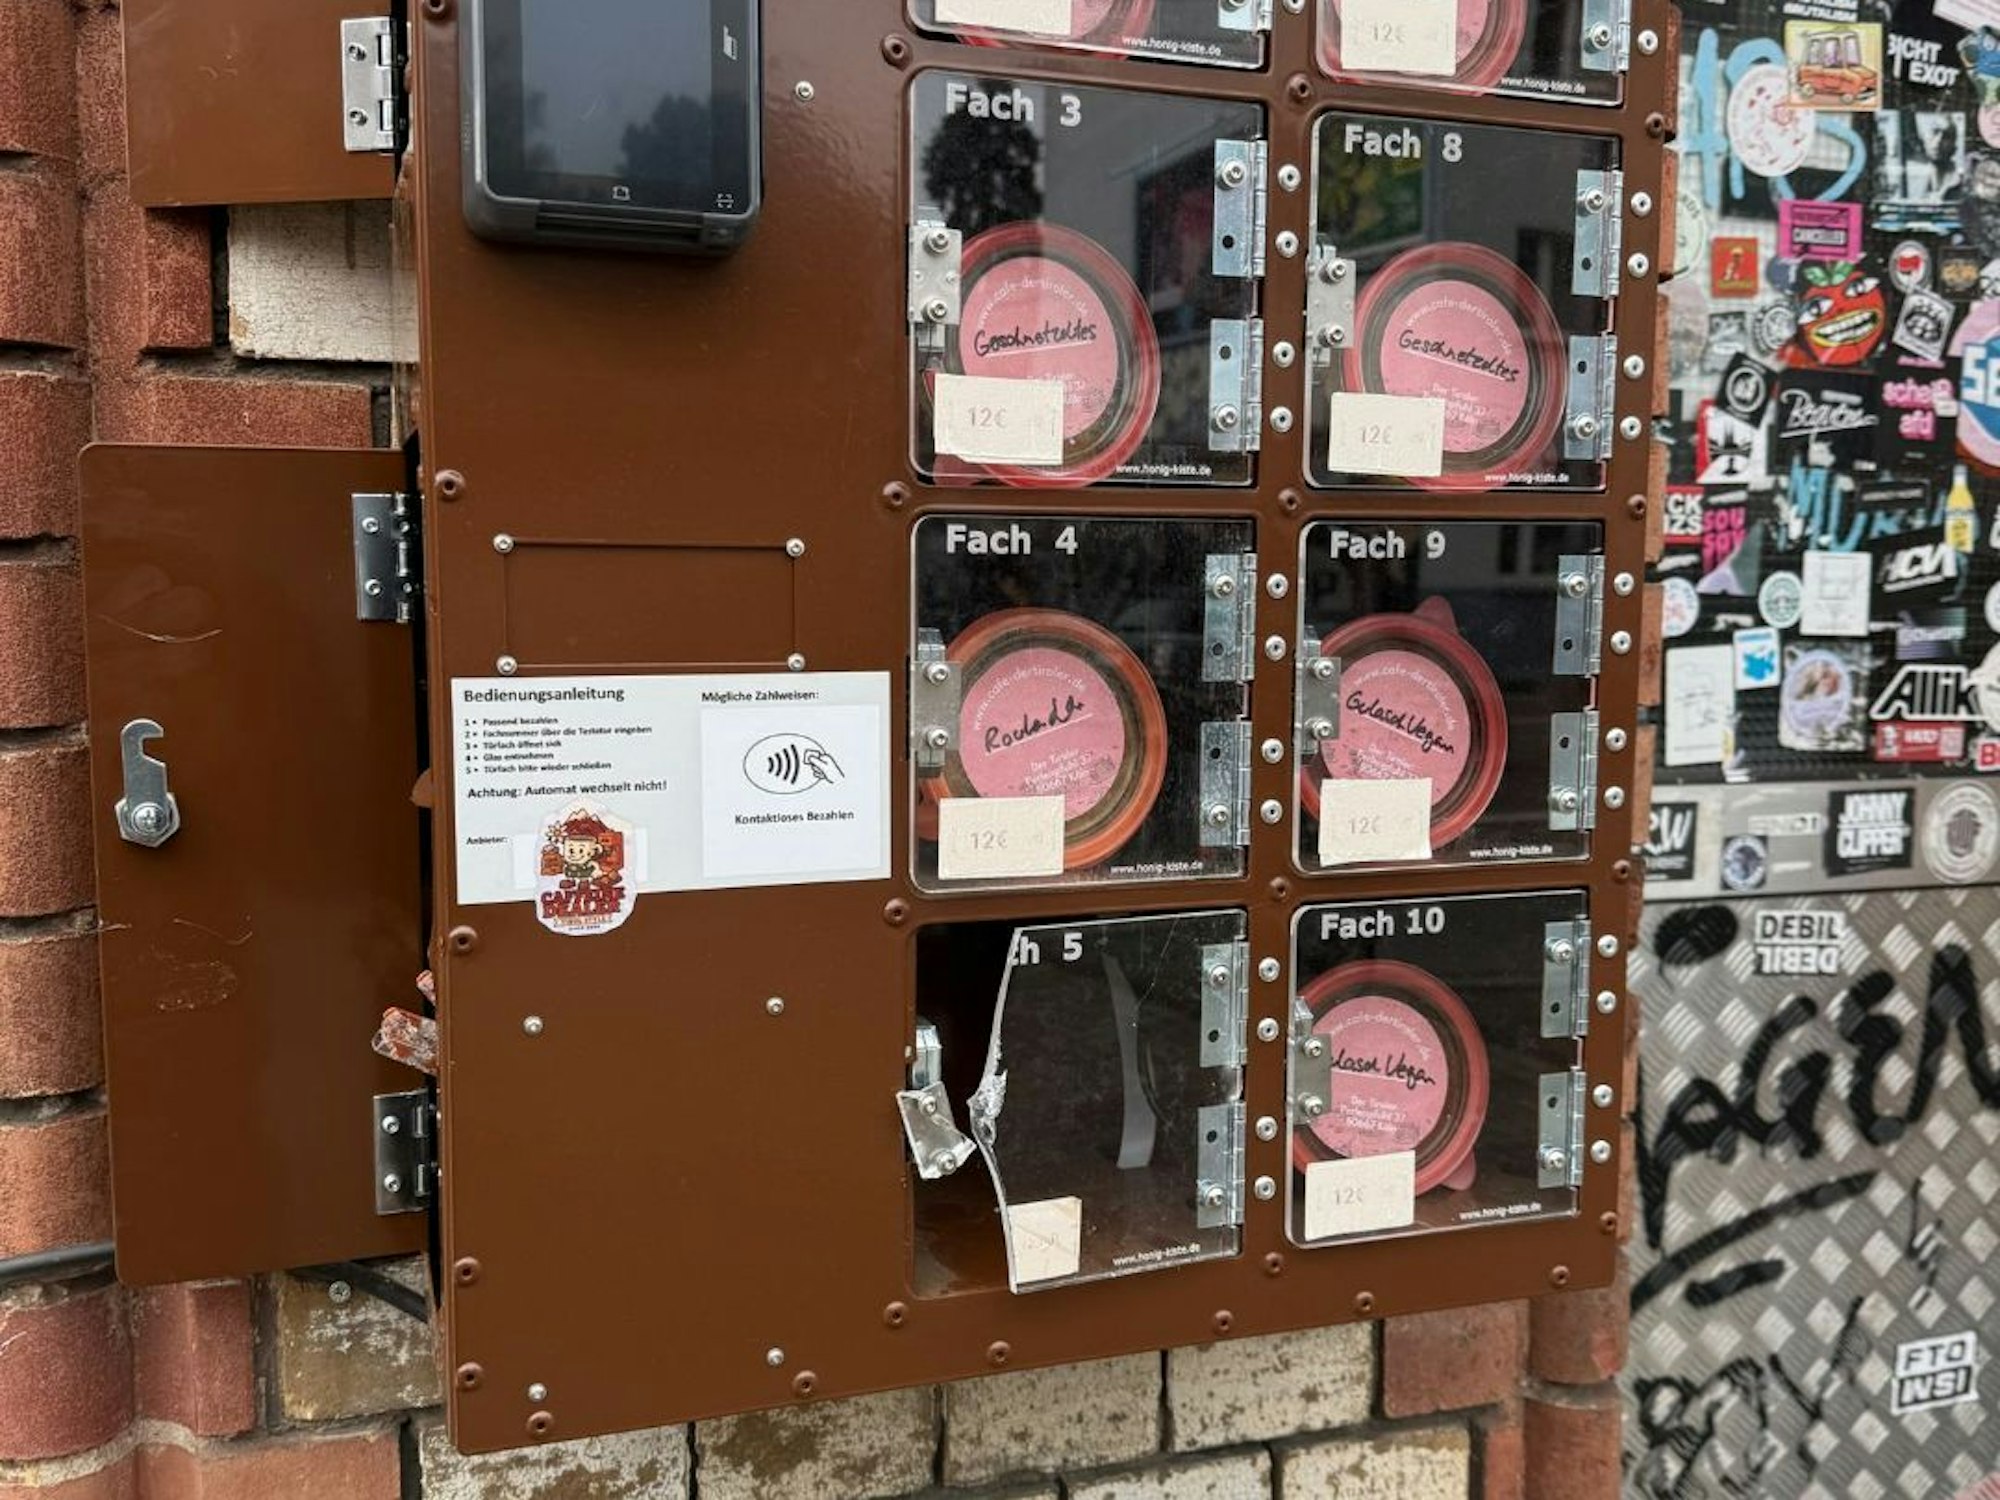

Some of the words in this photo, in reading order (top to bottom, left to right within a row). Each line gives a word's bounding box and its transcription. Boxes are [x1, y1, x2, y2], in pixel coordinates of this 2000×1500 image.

[1909, 60, 1961, 87] EXOT
[946, 83, 1035, 121] Fach
[1060, 95, 1081, 127] 3
[1345, 124, 1421, 158] Fach
[1442, 133, 1462, 163] 8
[968, 407, 1007, 428] 12€
[1361, 425, 1393, 444] 12€
[1116, 464, 1212, 477] www.honig-kiste.de
[1666, 493, 1703, 514] CK
[1663, 514, 1703, 535] ZS
[946, 523, 1031, 555] Fach
[1055, 526, 1078, 555] 4
[1330, 530, 1405, 559] Fach
[1426, 531, 1446, 559] 9
[464, 687, 624, 703] Bedienungsanleitung
[702, 692, 752, 703] Mögliche
[755, 691, 819, 701] Zahlweisen:
[1408, 715, 1455, 754] Vegan
[468, 787, 522, 799] Achtung:
[525, 784, 577, 796] Automat
[581, 781, 631, 794] wechselt
[634, 780, 667, 792] nicht!
[735, 813, 804, 824] Kontaktloses
[807, 811, 854, 821] Bezahlen
[971, 832, 1008, 849] 12€
[1111, 860, 1203, 876] www.honig-kiste.de
[1320, 909, 1394, 940] Fach
[1407, 907, 1445, 935] 10
[1762, 915, 1838, 939] DEBIL
[1063, 933, 1083, 962] 5
[1757, 945, 1838, 973] DEBIL
[1385, 1052, 1436, 1090] Vegan
[1112, 1242, 1201, 1267] www.honig-kiste.de
[1903, 1340, 1966, 1372] FTO
